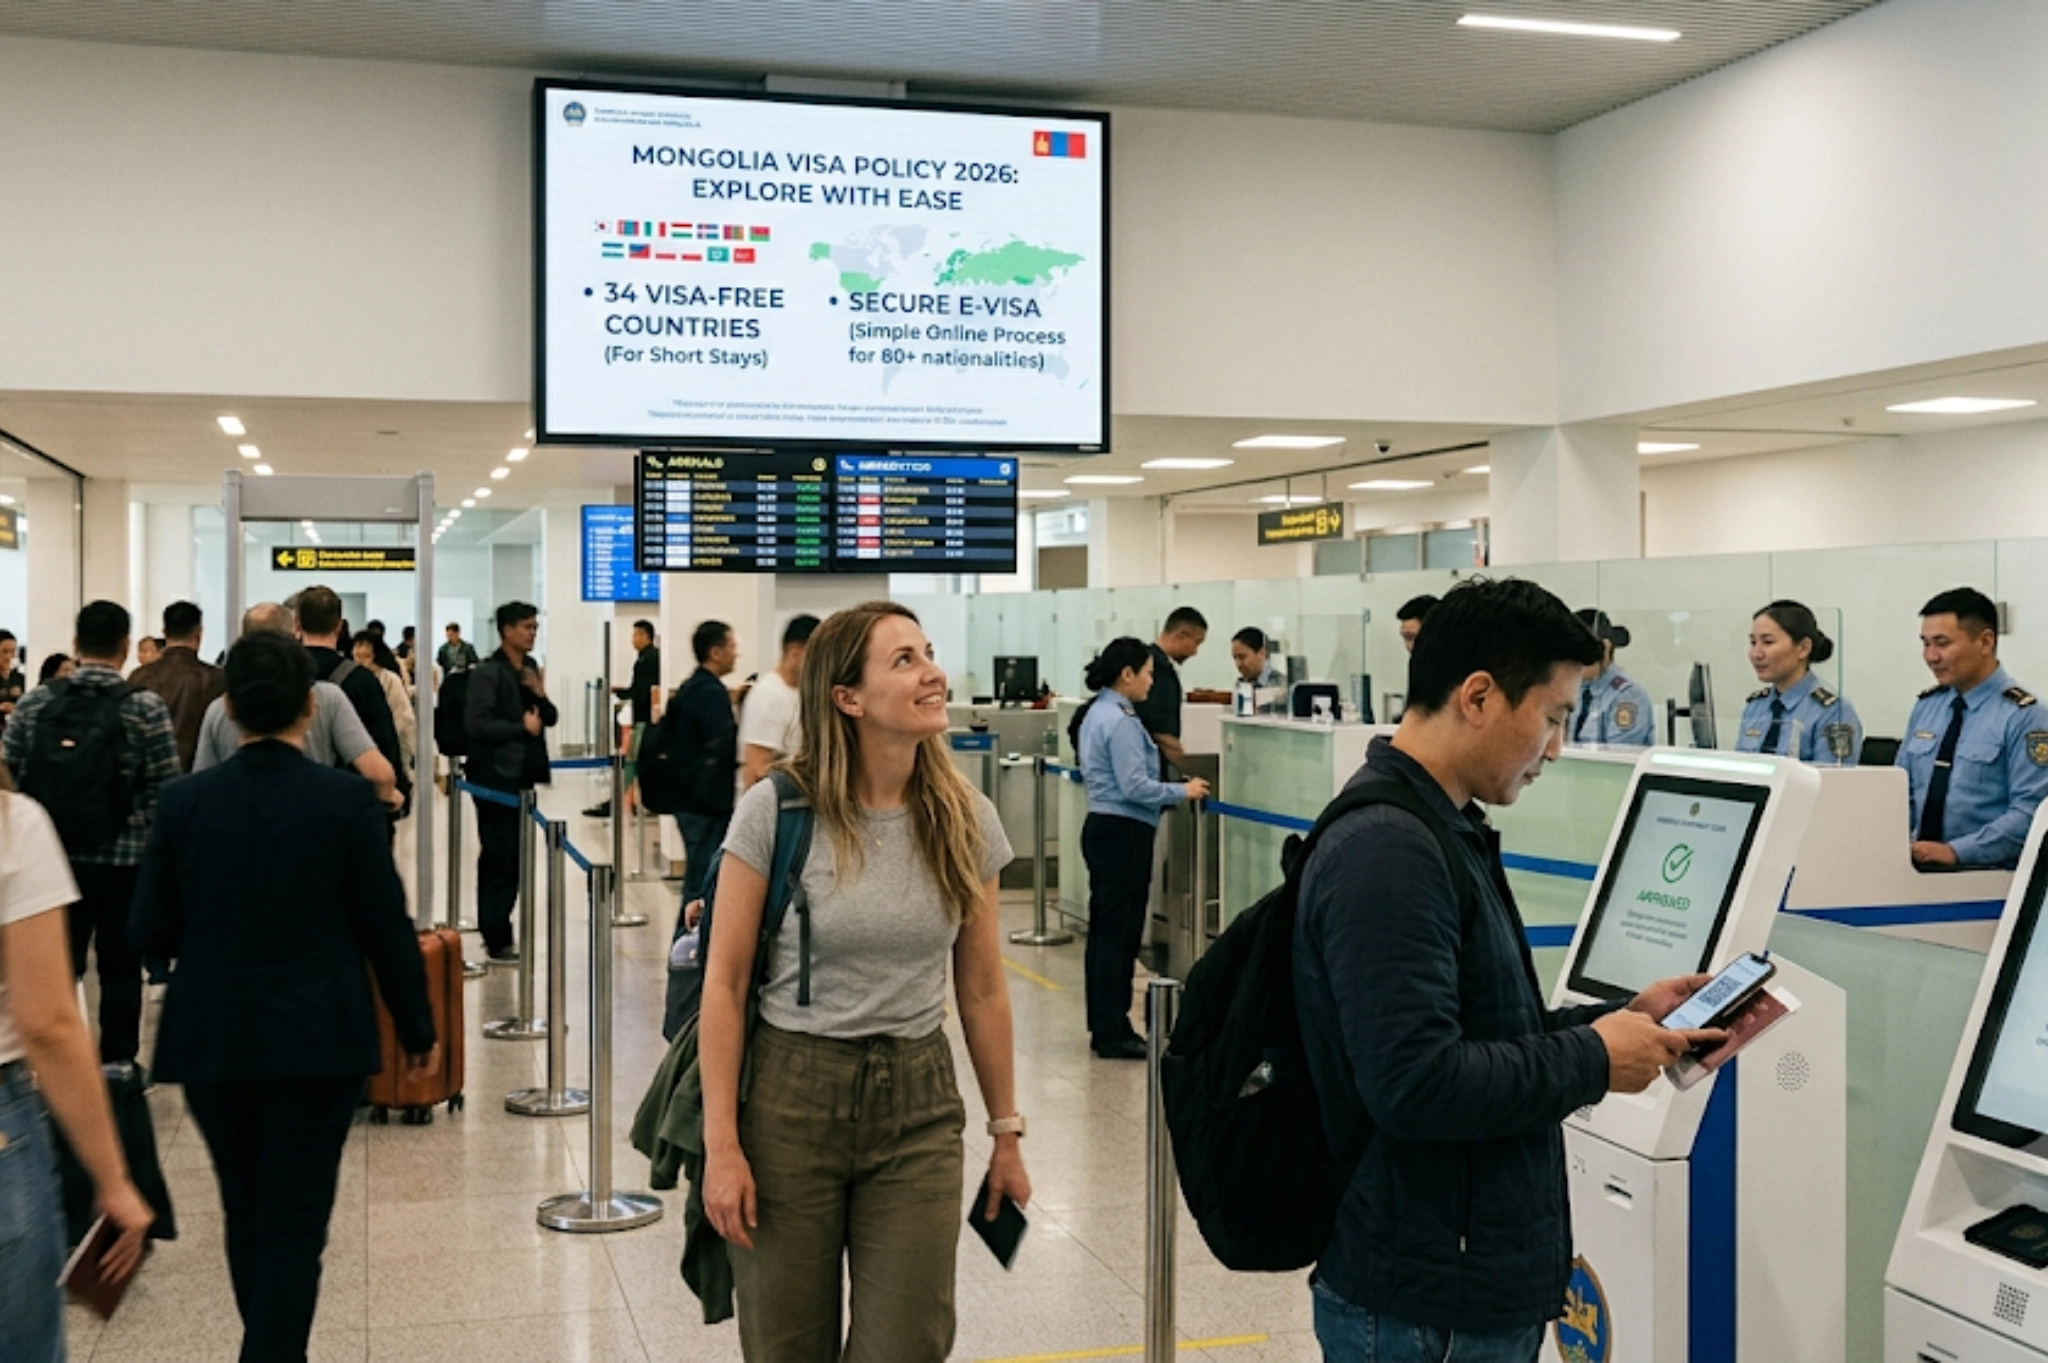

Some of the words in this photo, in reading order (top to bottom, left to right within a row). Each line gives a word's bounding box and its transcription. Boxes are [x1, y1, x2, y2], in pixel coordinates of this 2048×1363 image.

[632, 145, 779, 172] MONGOLIA
[786, 152, 846, 174] VISA
[854, 156, 946, 179] POLICY
[954, 162, 1018, 184] 2026:
[693, 179, 813, 204] EXPLORE
[821, 185, 890, 206] WITH
[898, 190, 963, 211] EASE
[604, 283, 639, 303] 34
[645, 284, 784, 309] VISA-FREE
[849, 291, 950, 315] SECURE
[959, 296, 1042, 318] E-VISA
[605, 314, 760, 339] COUNTRIES
[849, 321, 920, 343] (Simple
[994, 326, 1066, 344] Process
[604, 344, 643, 364] (For
[648, 346, 703, 365] Short
[709, 348, 768, 368] Stays)
[848, 346, 875, 363] for
[922, 349, 1045, 372] nationalities)
